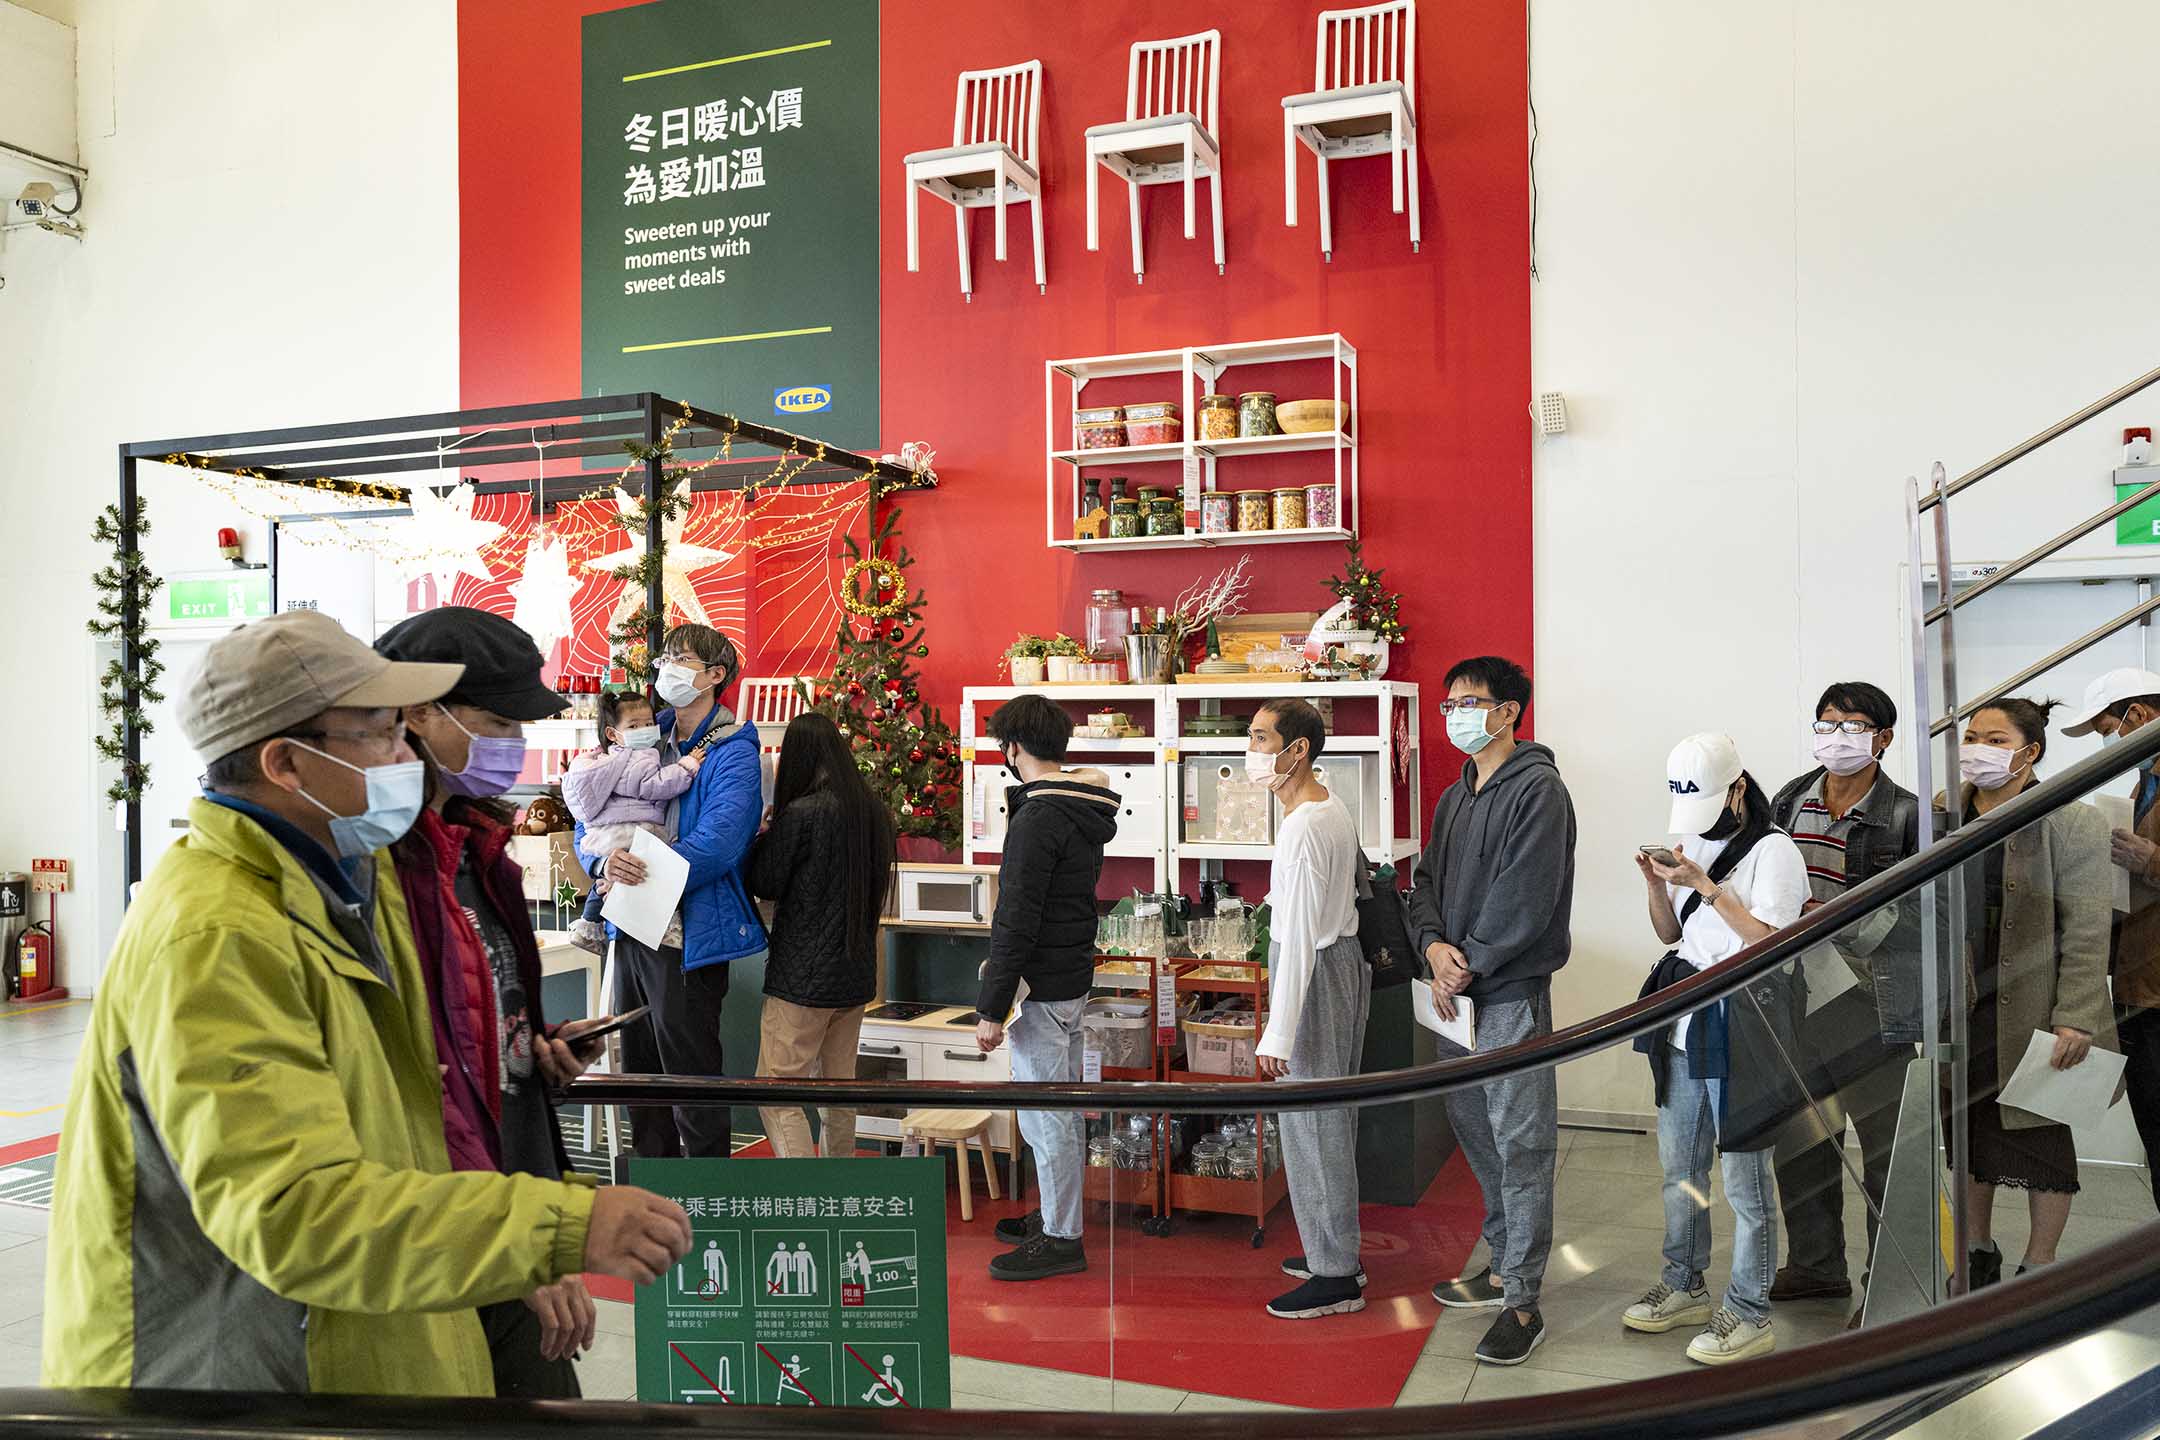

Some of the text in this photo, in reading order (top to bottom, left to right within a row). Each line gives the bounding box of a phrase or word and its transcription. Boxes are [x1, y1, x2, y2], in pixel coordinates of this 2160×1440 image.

[624, 87, 803, 153] 冬日暖心價
[624, 147, 766, 207] 為愛加溫
[624, 211, 771, 245] Sweeten up your
[624, 238, 750, 270] moments with
[624, 267, 725, 295] sweet deals
[780, 392, 827, 407] IKEA
[181, 603, 217, 616] EXIT
[1668, 780, 1700, 794] FILA
[875, 1270, 899, 1282] 100
